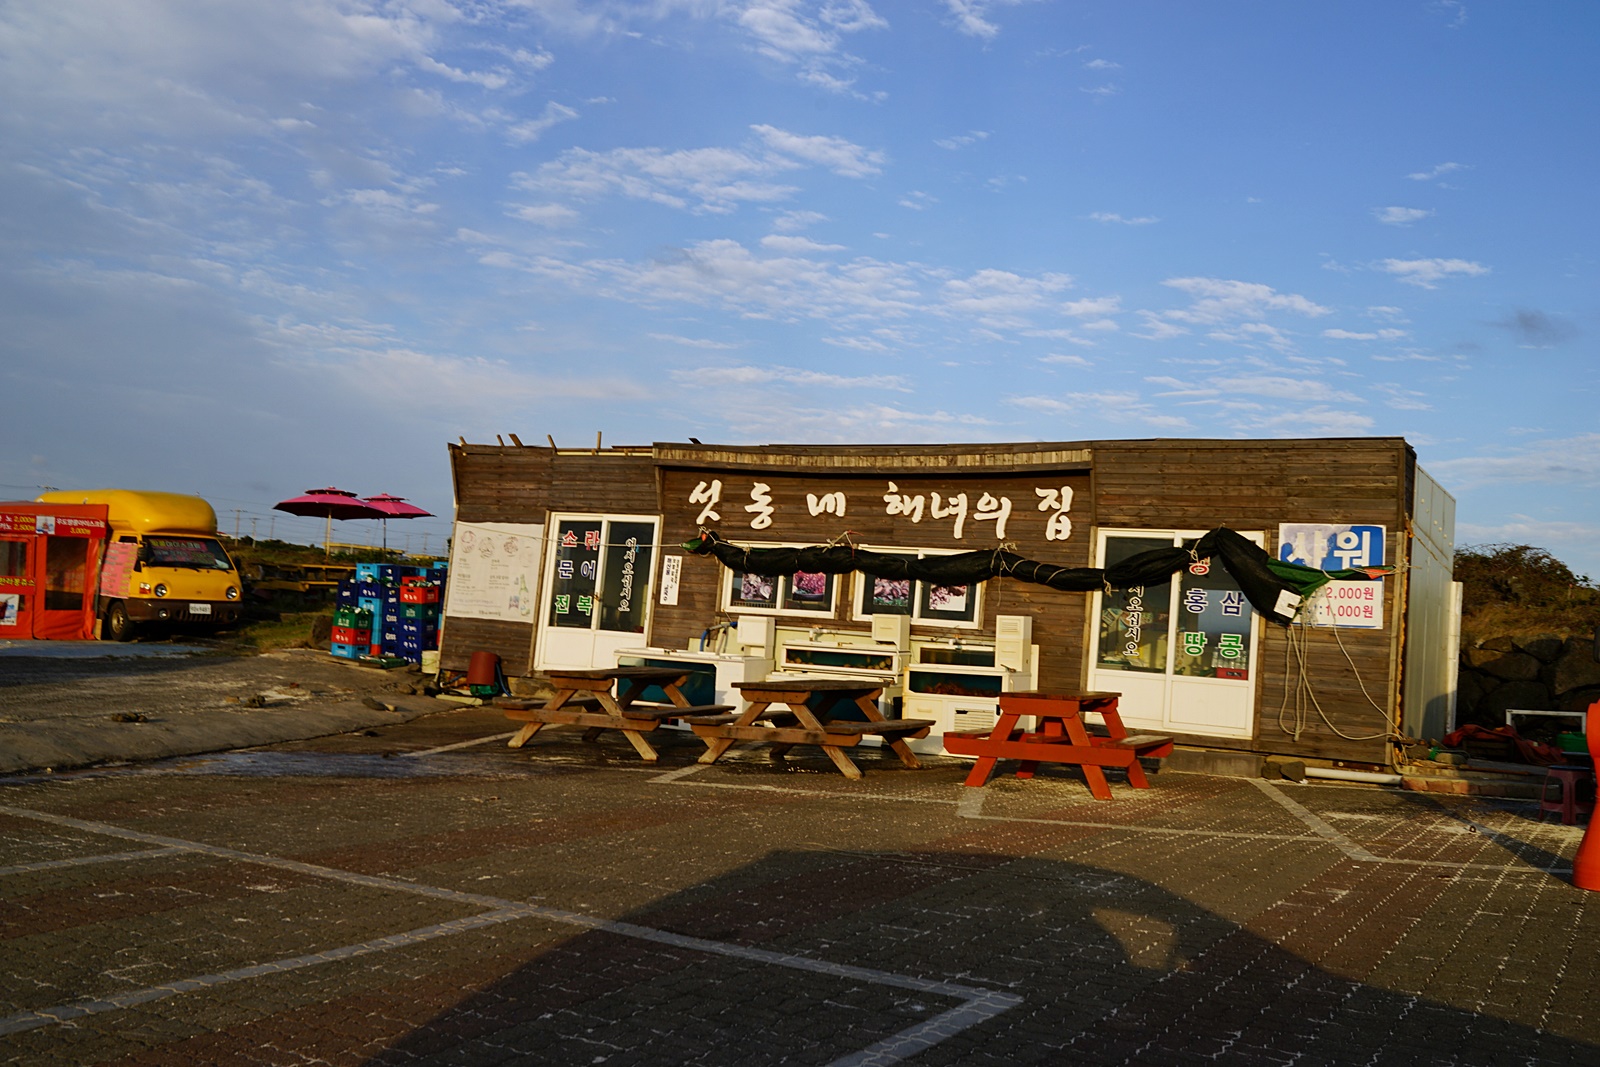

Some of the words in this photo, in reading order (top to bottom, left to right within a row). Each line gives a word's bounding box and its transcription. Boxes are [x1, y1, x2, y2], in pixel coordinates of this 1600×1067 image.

[883, 481, 1012, 540] 해녀의
[1035, 485, 1073, 541] 집
[561, 530, 601, 551] 소라
[1286, 530, 1371, 569] 샤워
[557, 559, 597, 580] 문어
[554, 594, 593, 616] 전복
[1183, 587, 1245, 617] 홍삼
[1326, 587, 1374, 601] 2,000원
[1326, 605, 1374, 619] 1,000원
[1184, 631, 1244, 659] 땅콩
